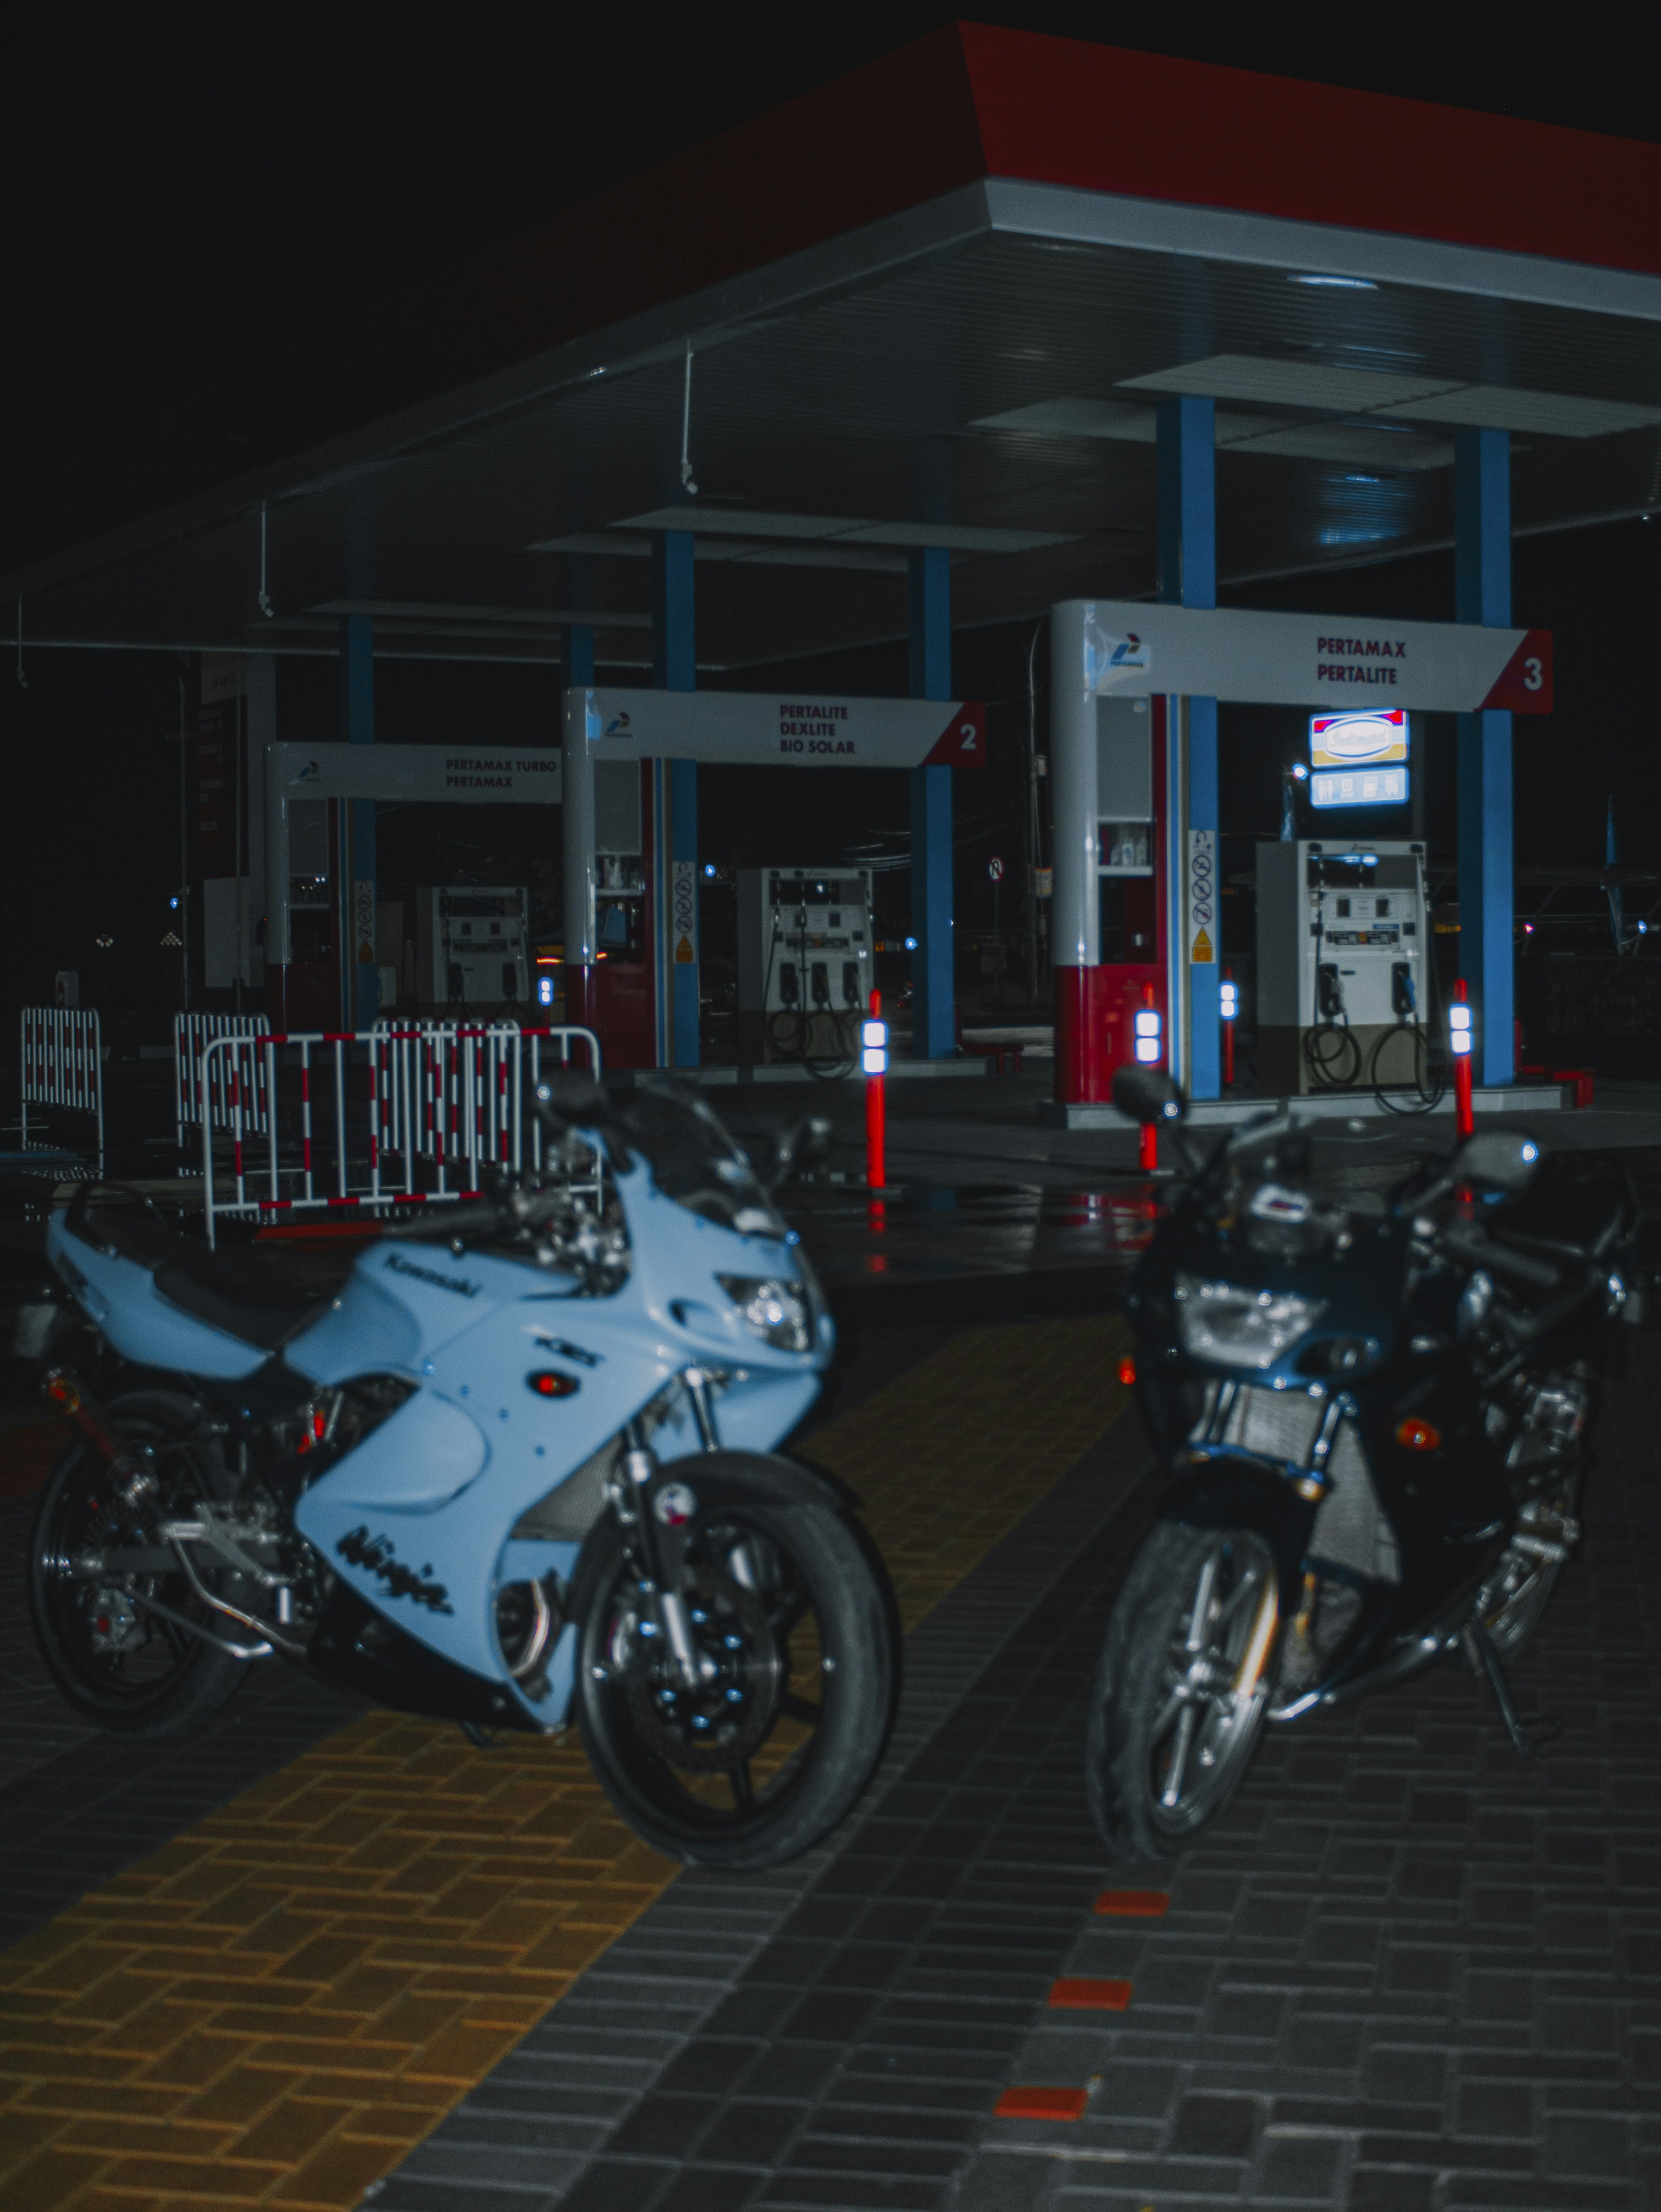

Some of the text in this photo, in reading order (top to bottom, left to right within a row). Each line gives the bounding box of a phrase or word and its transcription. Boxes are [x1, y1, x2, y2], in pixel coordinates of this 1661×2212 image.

[1318, 637, 1406, 658] PERTAMAX
[1318, 664, 1397, 685] PERTALITE
[1523, 657, 1542, 691] 3
[780, 705, 848, 720] PERTALITE
[780, 722, 836, 737] DEXLITE
[960, 724, 976, 750] 2
[780, 739, 855, 754] BIO SOLAR
[446, 759, 556, 772] PERTAMAX TURBO
[446, 776, 513, 788] PERTAMAX
